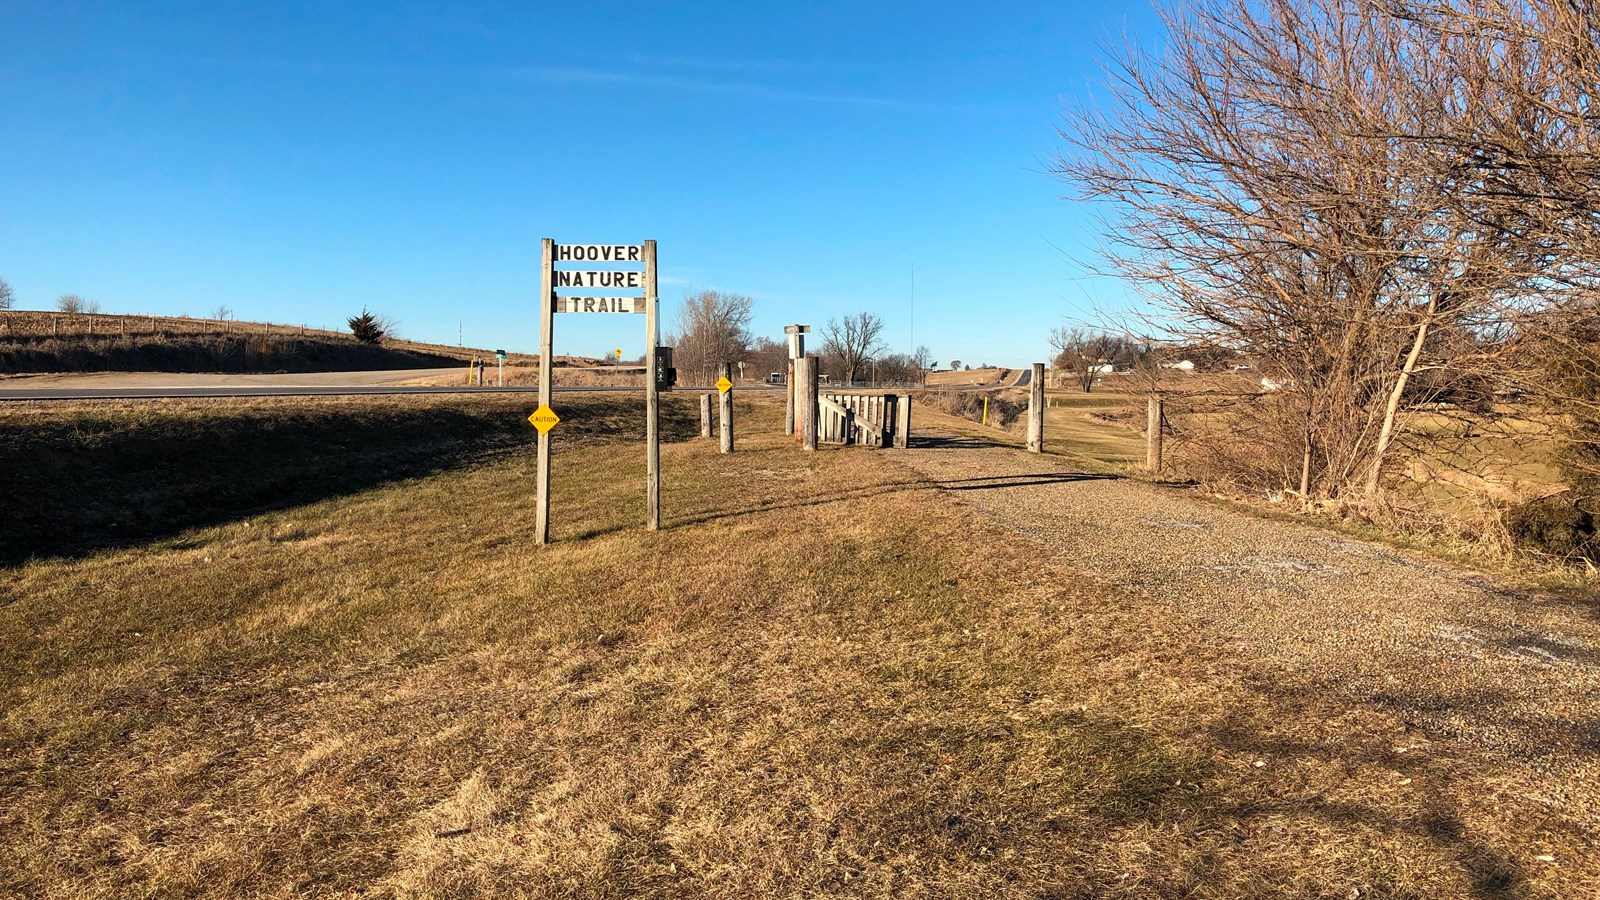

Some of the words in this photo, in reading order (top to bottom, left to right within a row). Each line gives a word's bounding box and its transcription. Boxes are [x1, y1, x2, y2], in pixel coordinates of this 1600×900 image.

[560, 245, 639, 261] HOOVER
[559, 271, 639, 287] NATURE
[570, 297, 629, 312] TRAIL
